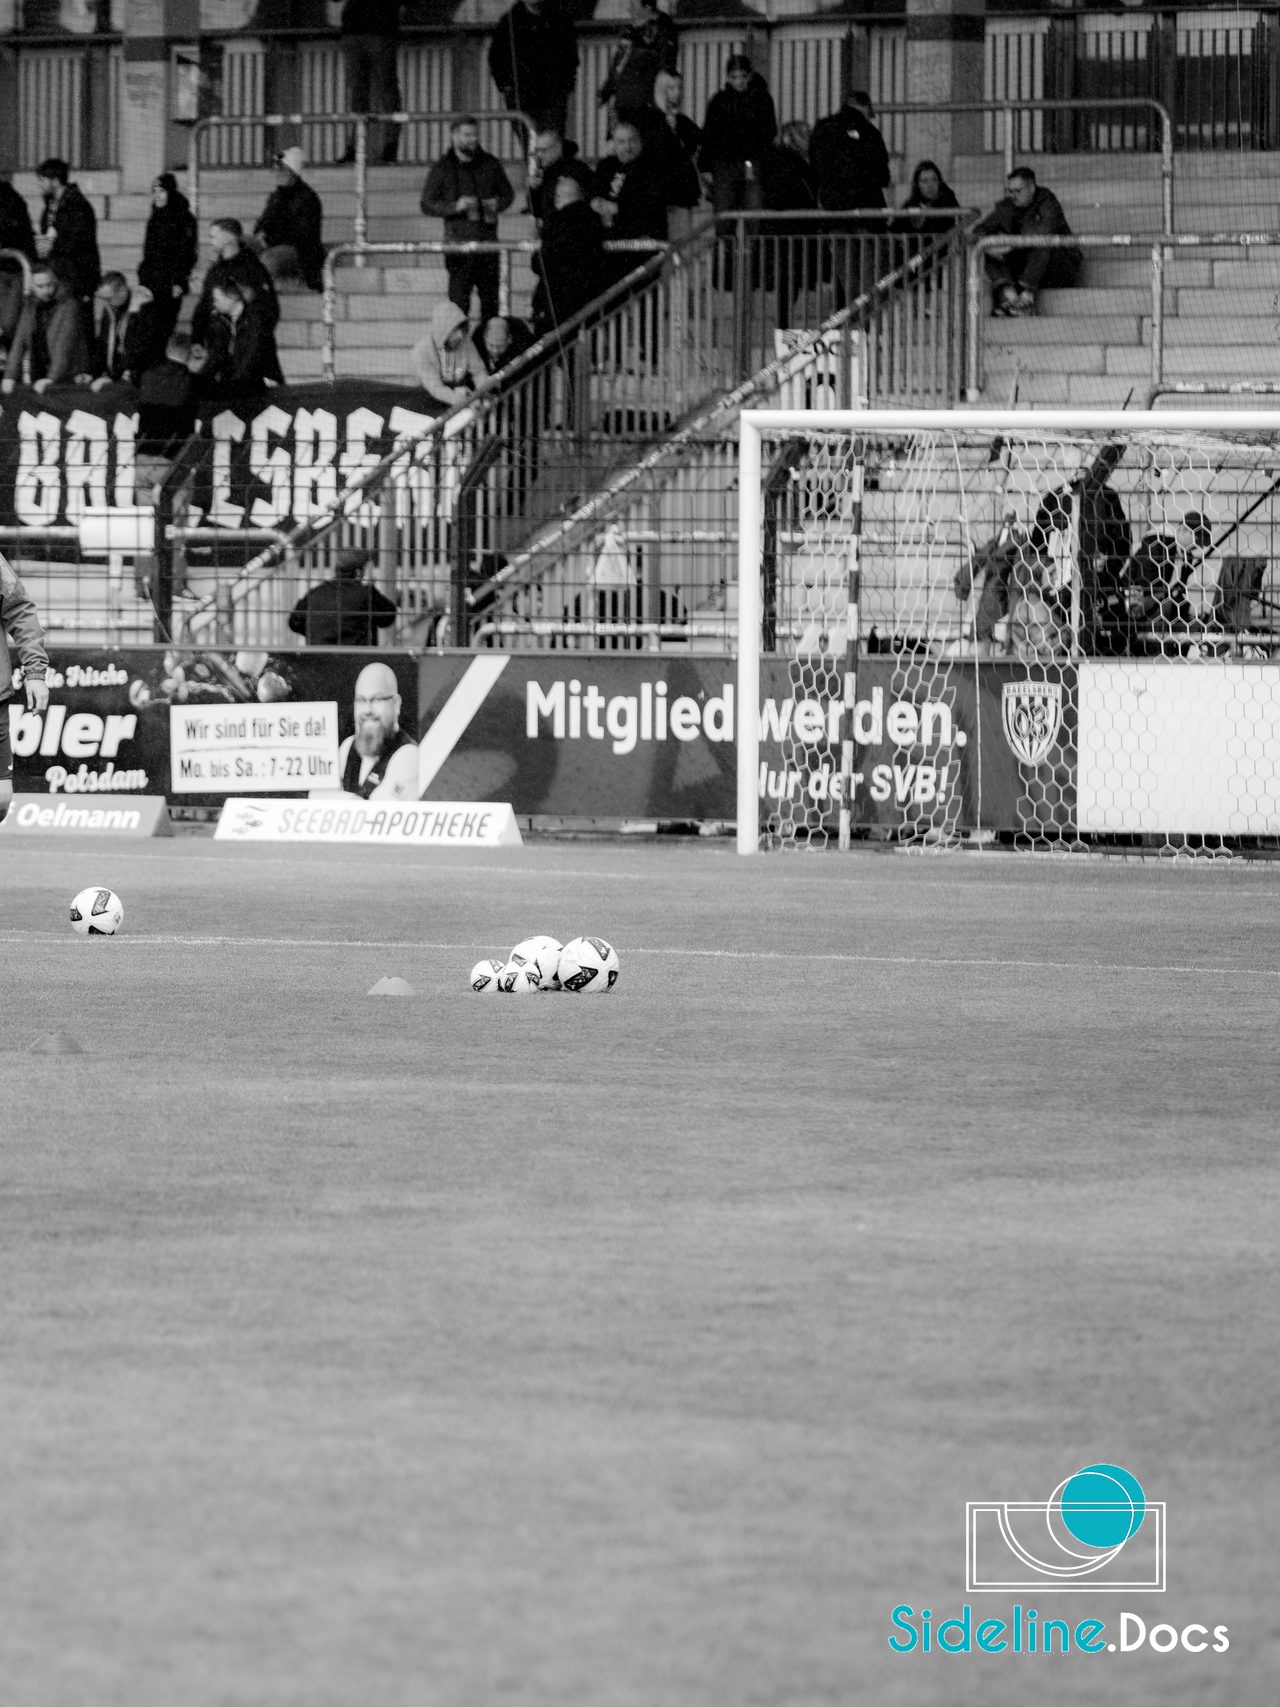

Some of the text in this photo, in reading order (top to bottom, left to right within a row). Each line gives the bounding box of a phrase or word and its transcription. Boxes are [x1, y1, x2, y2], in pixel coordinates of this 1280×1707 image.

[185, 716, 326, 739] Wir sind für Sie da!
[526, 679, 968, 755] Mitglied werden.
[45, 762, 149, 793] Potsdam
[211, 759, 230, 778] bis
[308, 755, 334, 776] Uhr
[808, 763, 864, 800] der
[870, 764, 949, 803] SVB!
[17, 802, 142, 830] Oelmann
